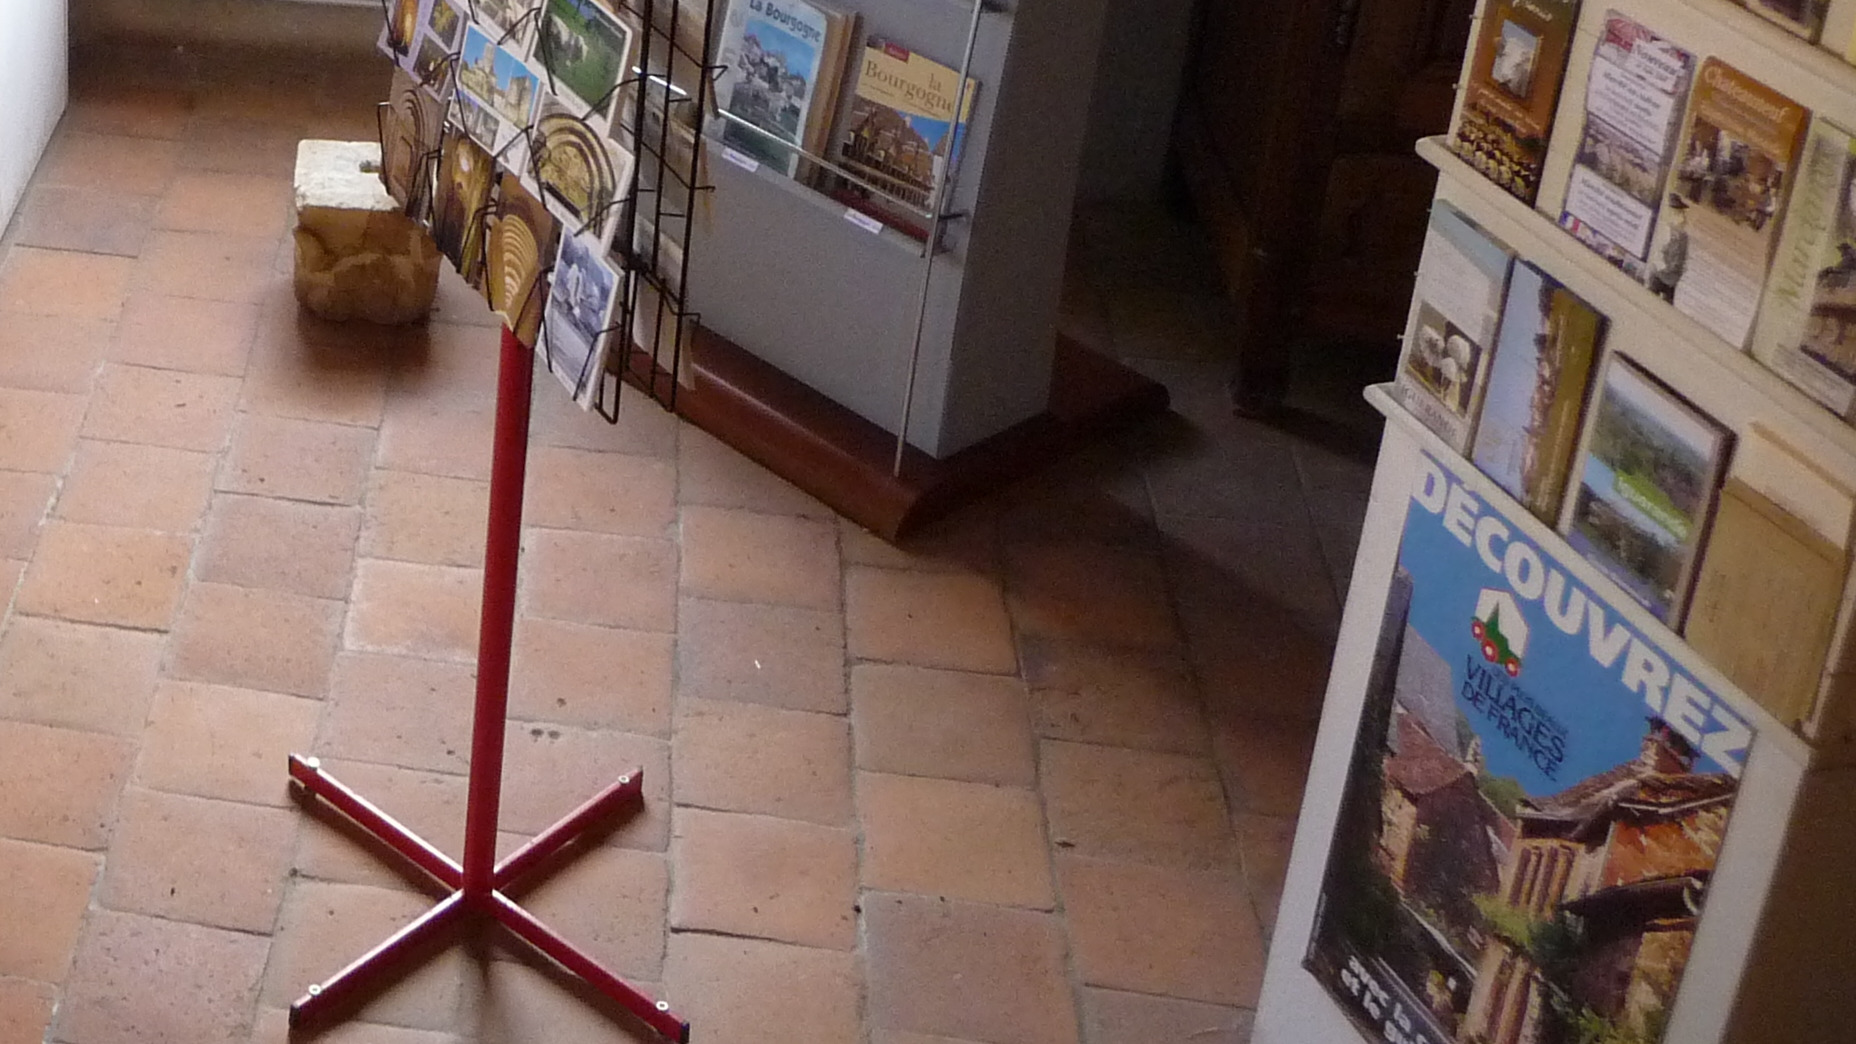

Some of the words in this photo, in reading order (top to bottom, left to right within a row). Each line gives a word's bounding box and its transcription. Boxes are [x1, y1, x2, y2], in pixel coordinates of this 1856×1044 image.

[764, 2, 822, 43] Bourgogne
[864, 59, 955, 114] Bourgogne
[928, 72, 943, 92] la
[1461, 680, 1485, 714] DE
[1487, 702, 1558, 783] FRANCE
[1467, 653, 1565, 763] VILLAGES
[1340, 968, 1361, 997] et
[1363, 989, 1381, 1020] le
[1347, 954, 1390, 1008] avec
[1393, 1002, 1412, 1034] la
